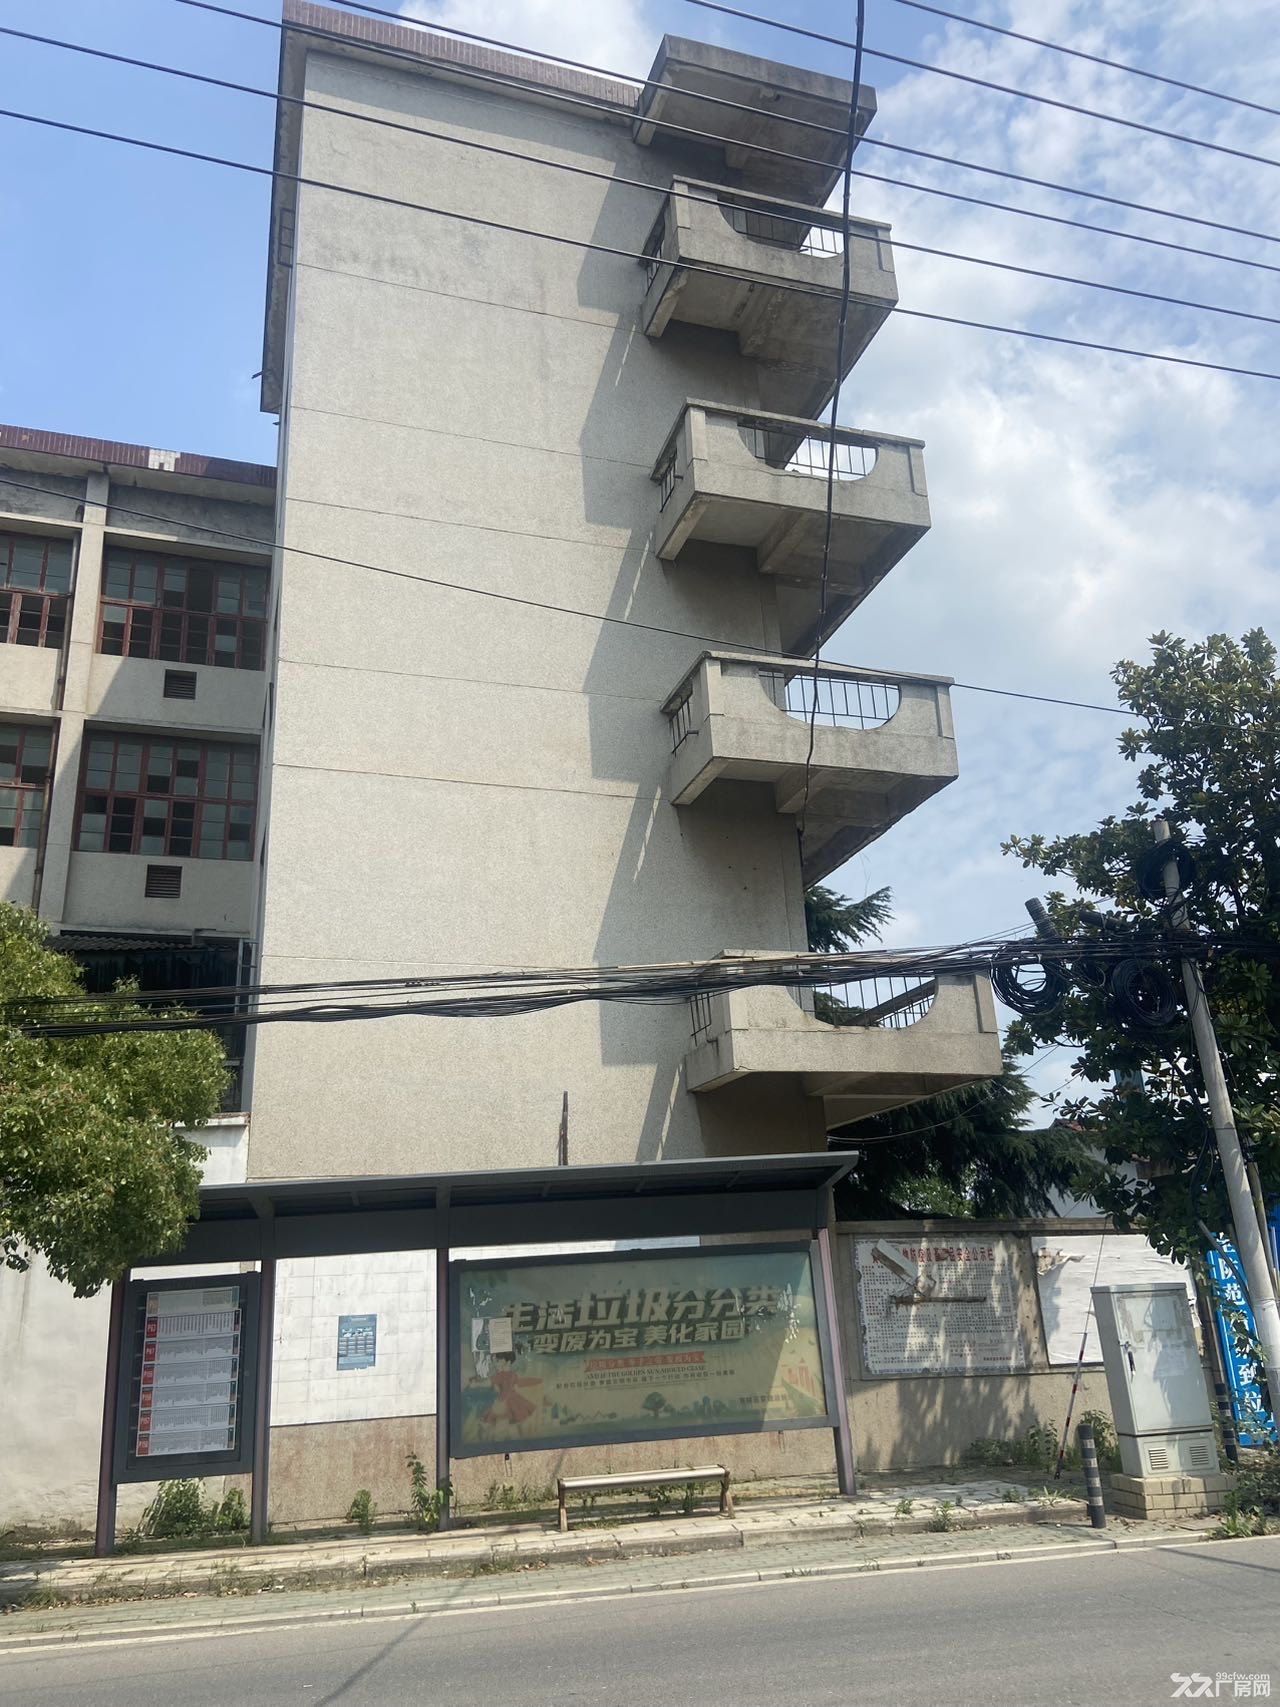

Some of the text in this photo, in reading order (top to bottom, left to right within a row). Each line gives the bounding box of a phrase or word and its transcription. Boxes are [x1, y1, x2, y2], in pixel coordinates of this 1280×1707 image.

[533, 1327, 638, 1353] 变废为宝
[645, 1320, 744, 1344] 美化家园
